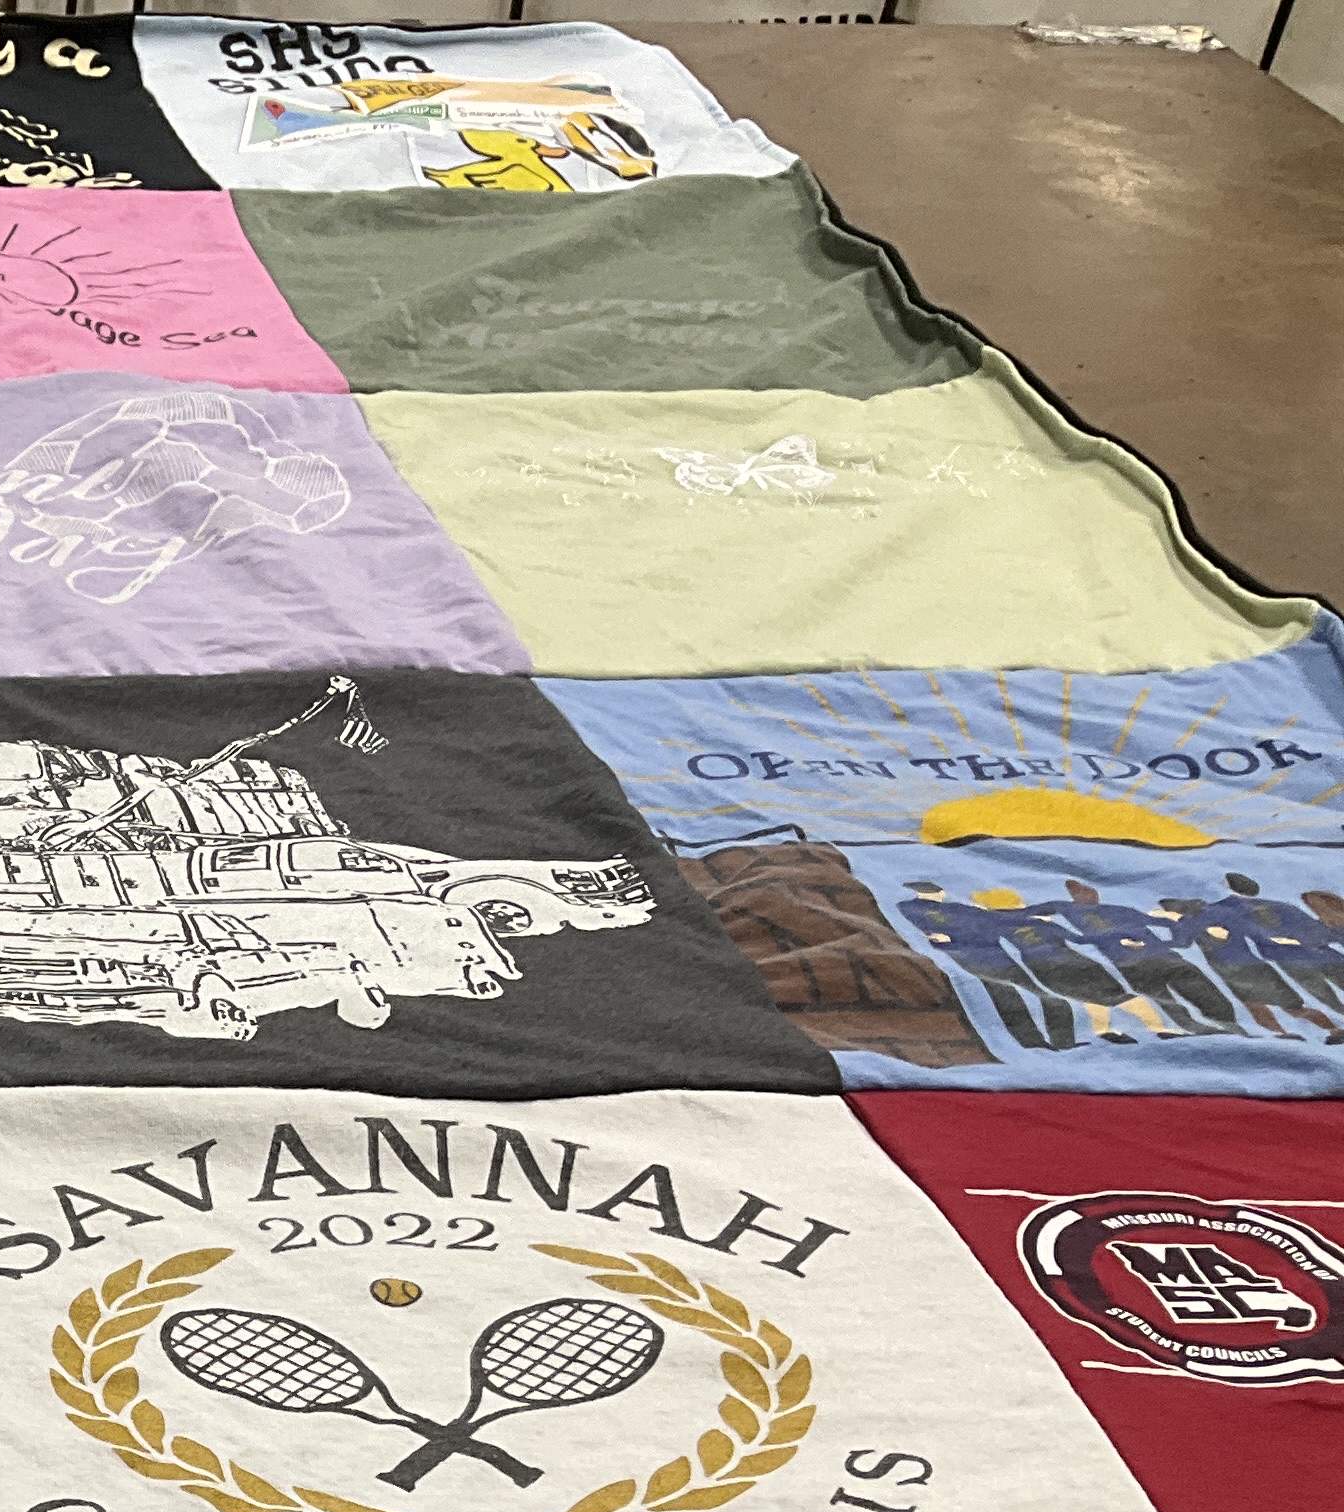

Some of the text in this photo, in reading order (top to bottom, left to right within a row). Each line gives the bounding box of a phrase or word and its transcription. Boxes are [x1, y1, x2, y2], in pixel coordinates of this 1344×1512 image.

[686, 737, 1323, 783] OPEN THE DOOR
[258, 1211, 501, 1256] 2022
[1101, 1212, 1195, 1231] MISSOURI
[1198, 1217, 1323, 1274] ASSOCIATION
[1105, 1306, 1288, 1363] STUDENT COUNCILS
